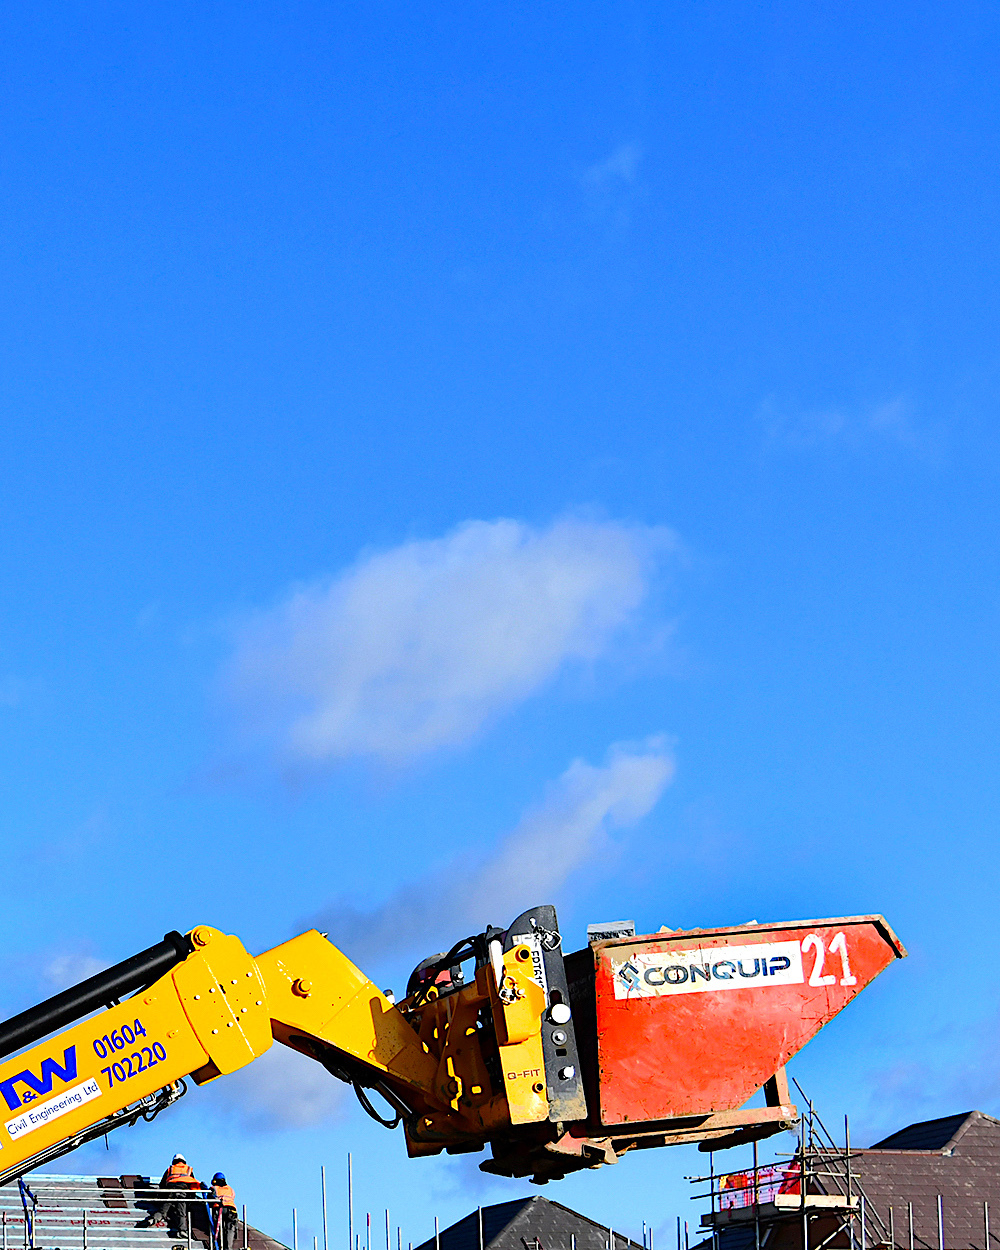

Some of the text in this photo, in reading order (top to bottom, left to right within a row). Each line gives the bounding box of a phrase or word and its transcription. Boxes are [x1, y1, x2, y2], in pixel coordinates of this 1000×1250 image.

[643, 956, 791, 987] CONQUIP
[800, 931, 858, 987] 21
[93, 1018, 147, 1059] 01604
[101, 1041, 167, 1088] 702220
[507, 1069, 541, 1080] Q-FIT
[7, 1081, 99, 1135] Civil Engineering Ltd
